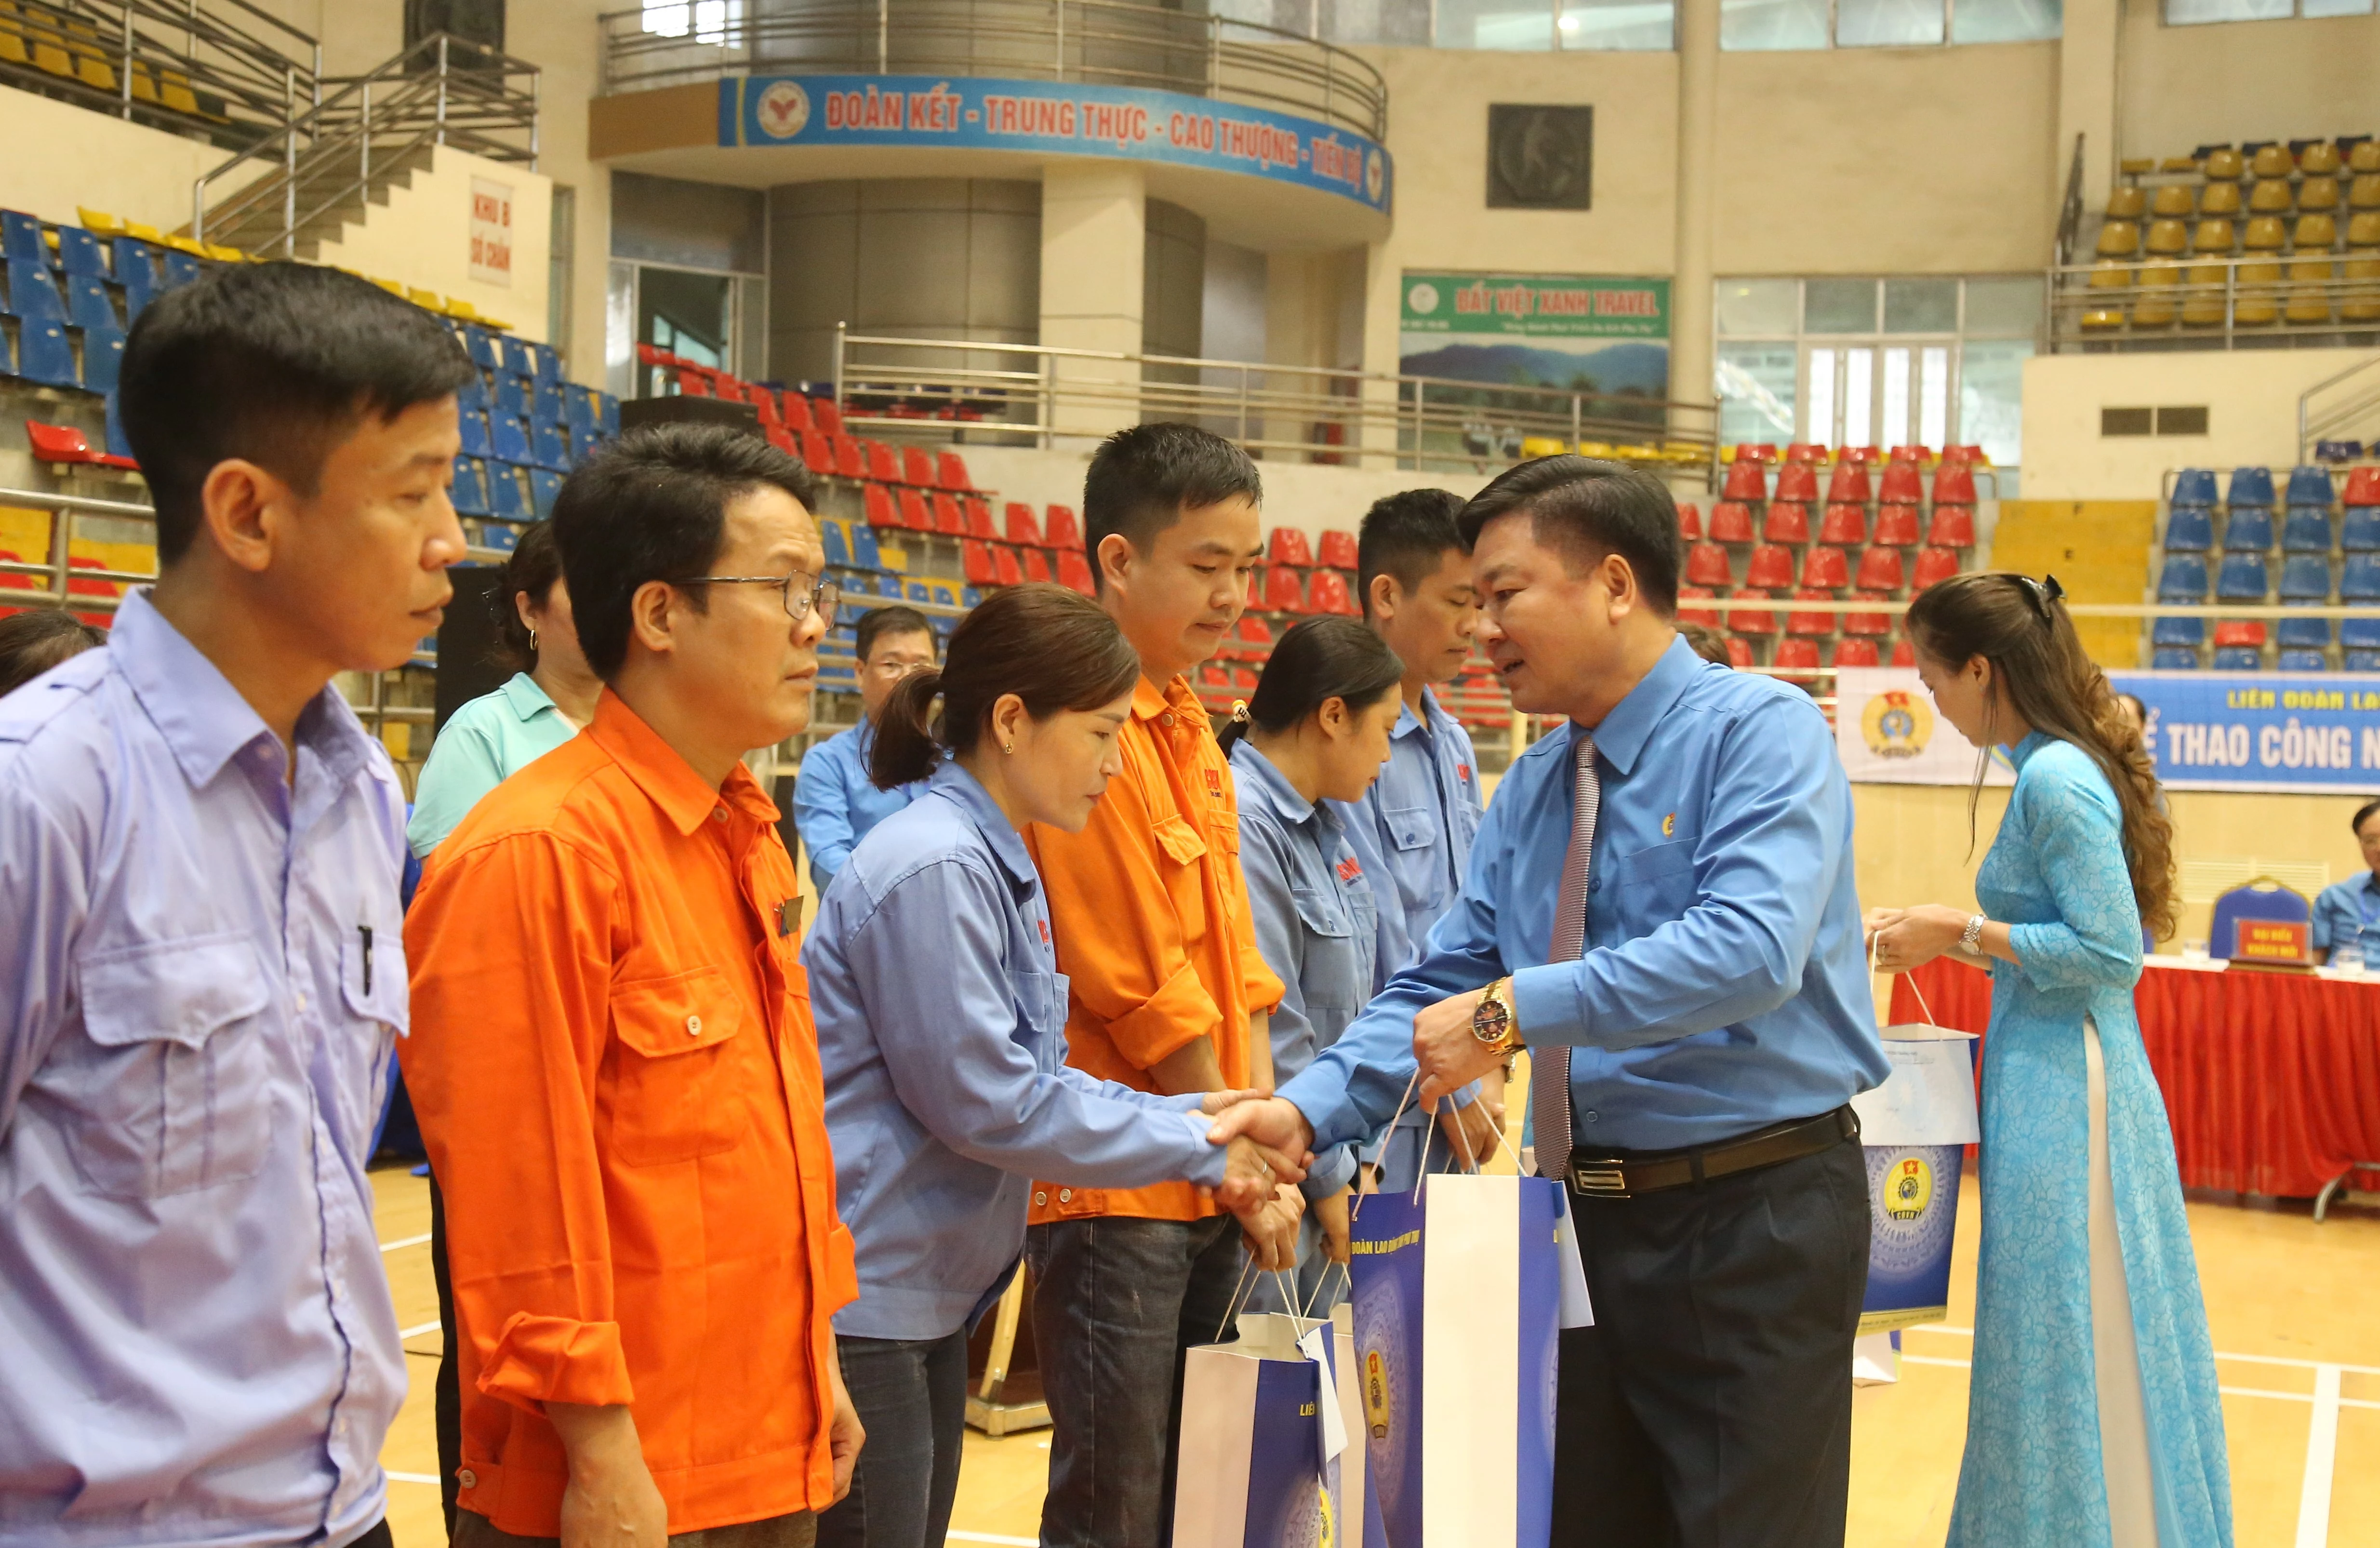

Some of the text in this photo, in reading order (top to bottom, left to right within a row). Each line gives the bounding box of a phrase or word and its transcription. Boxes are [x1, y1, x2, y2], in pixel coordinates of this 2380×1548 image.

[826, 84, 903, 130] ĐOÀN
[908, 82, 962, 132] KẾT
[984, 94, 1076, 138] TRUNG
[1082, 102, 1147, 149] THỰC
[1169, 112, 1213, 153] CAO
[1219, 119, 1299, 171] THƯỢNG
[1496, 283, 1534, 320] VIỆT
[1539, 289, 1590, 315] XANH
[1594, 290, 1660, 316] TRAVEL
[2227, 688, 2275, 708] LIÊN
[2282, 688, 2345, 710] ĐOÀN
[2166, 723, 2250, 767] THAO
[2259, 717, 2352, 769] CÔNG
